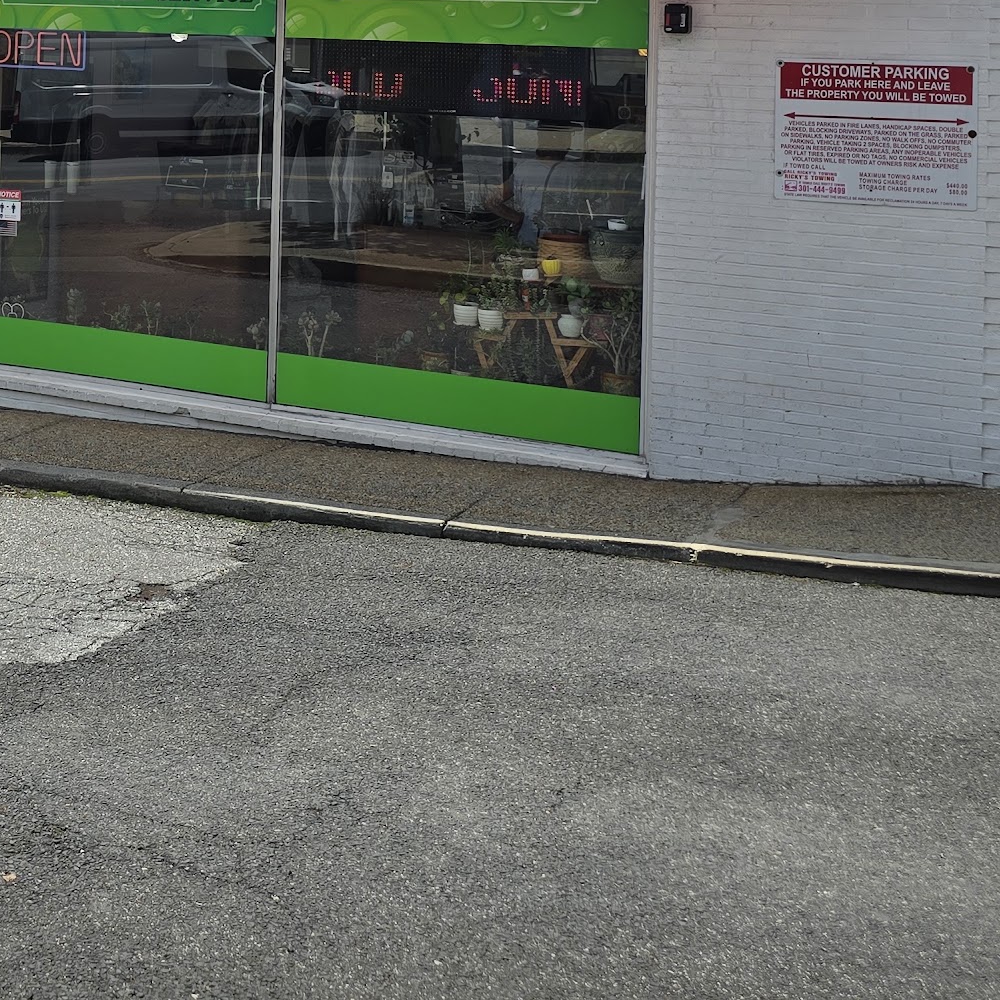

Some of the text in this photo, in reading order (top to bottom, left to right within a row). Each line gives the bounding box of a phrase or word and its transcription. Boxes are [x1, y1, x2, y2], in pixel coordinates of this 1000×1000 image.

[802, 64, 949, 80] CUSTOMER PARKING
[801, 78, 950, 91] IF YOU PARK HERE AND LEAVE
[785, 89, 966, 103] THE PROPERTY YOU WILL BE TOWED
[924, 144, 962, 152] DUMPSTERS,
[799, 185, 846, 194] 301-444-9499
